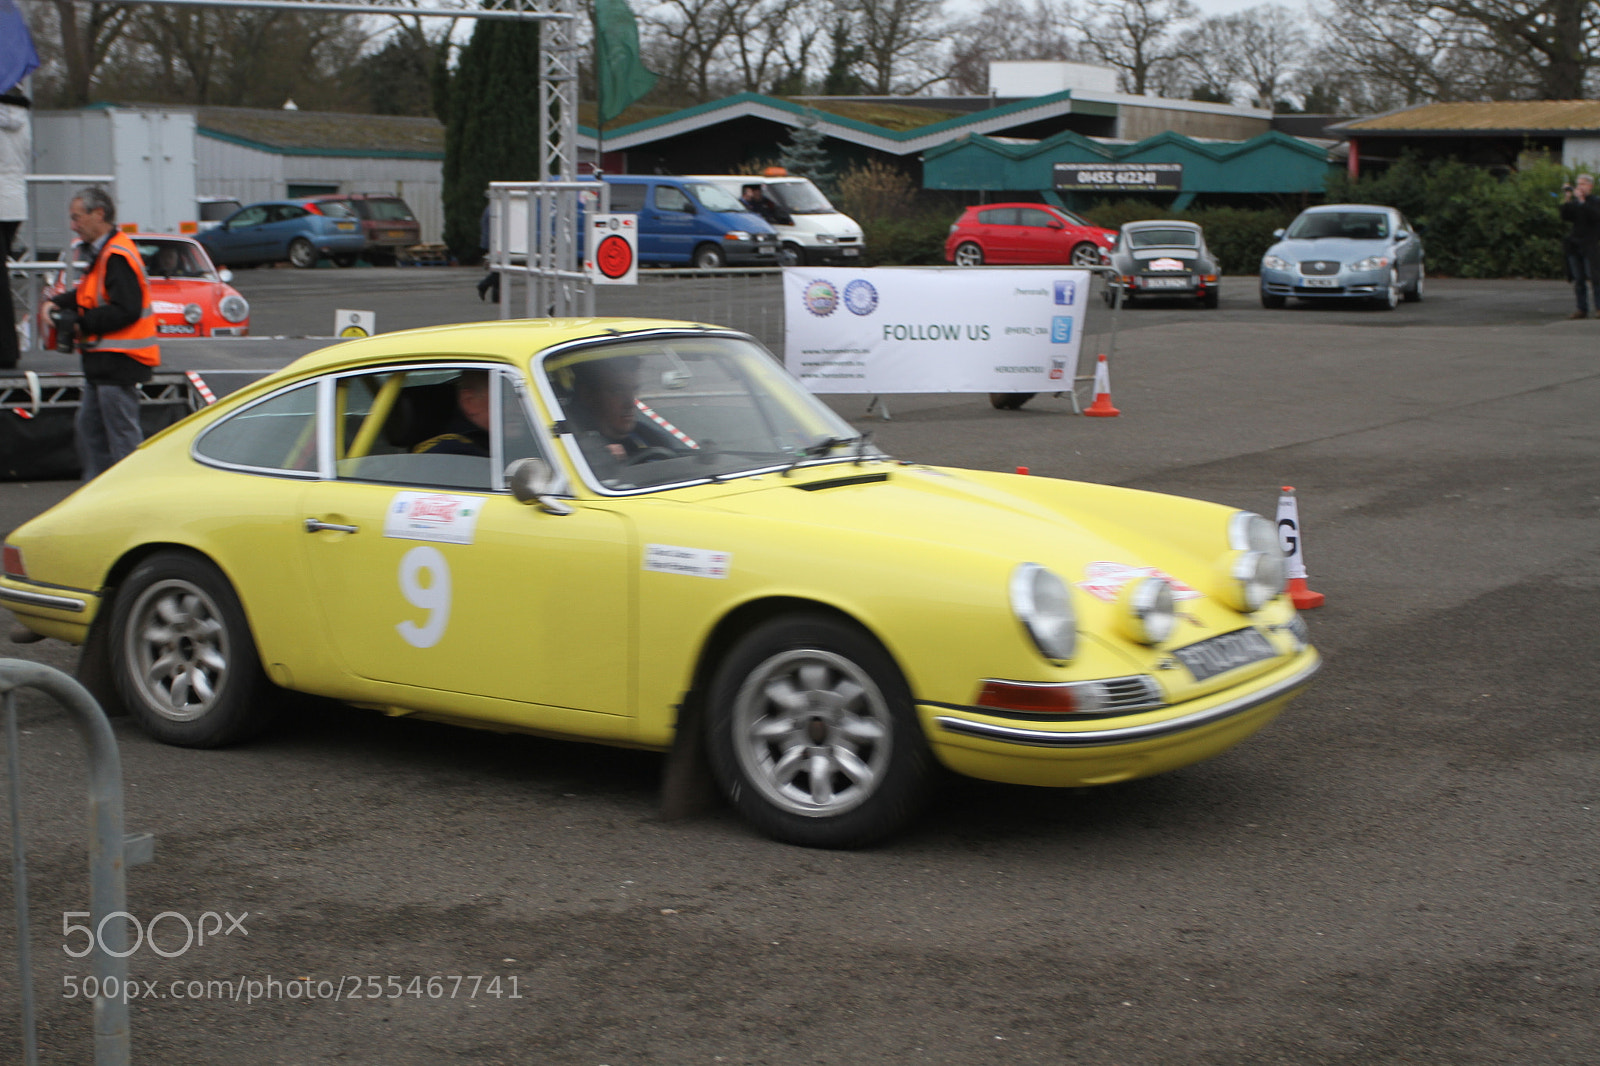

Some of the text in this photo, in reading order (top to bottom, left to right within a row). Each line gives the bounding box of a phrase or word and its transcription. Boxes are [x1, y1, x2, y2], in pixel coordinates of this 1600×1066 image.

[883, 324, 991, 341] FOLLOW US
[1278, 518, 1298, 557] G
[395, 545, 453, 649] 9
